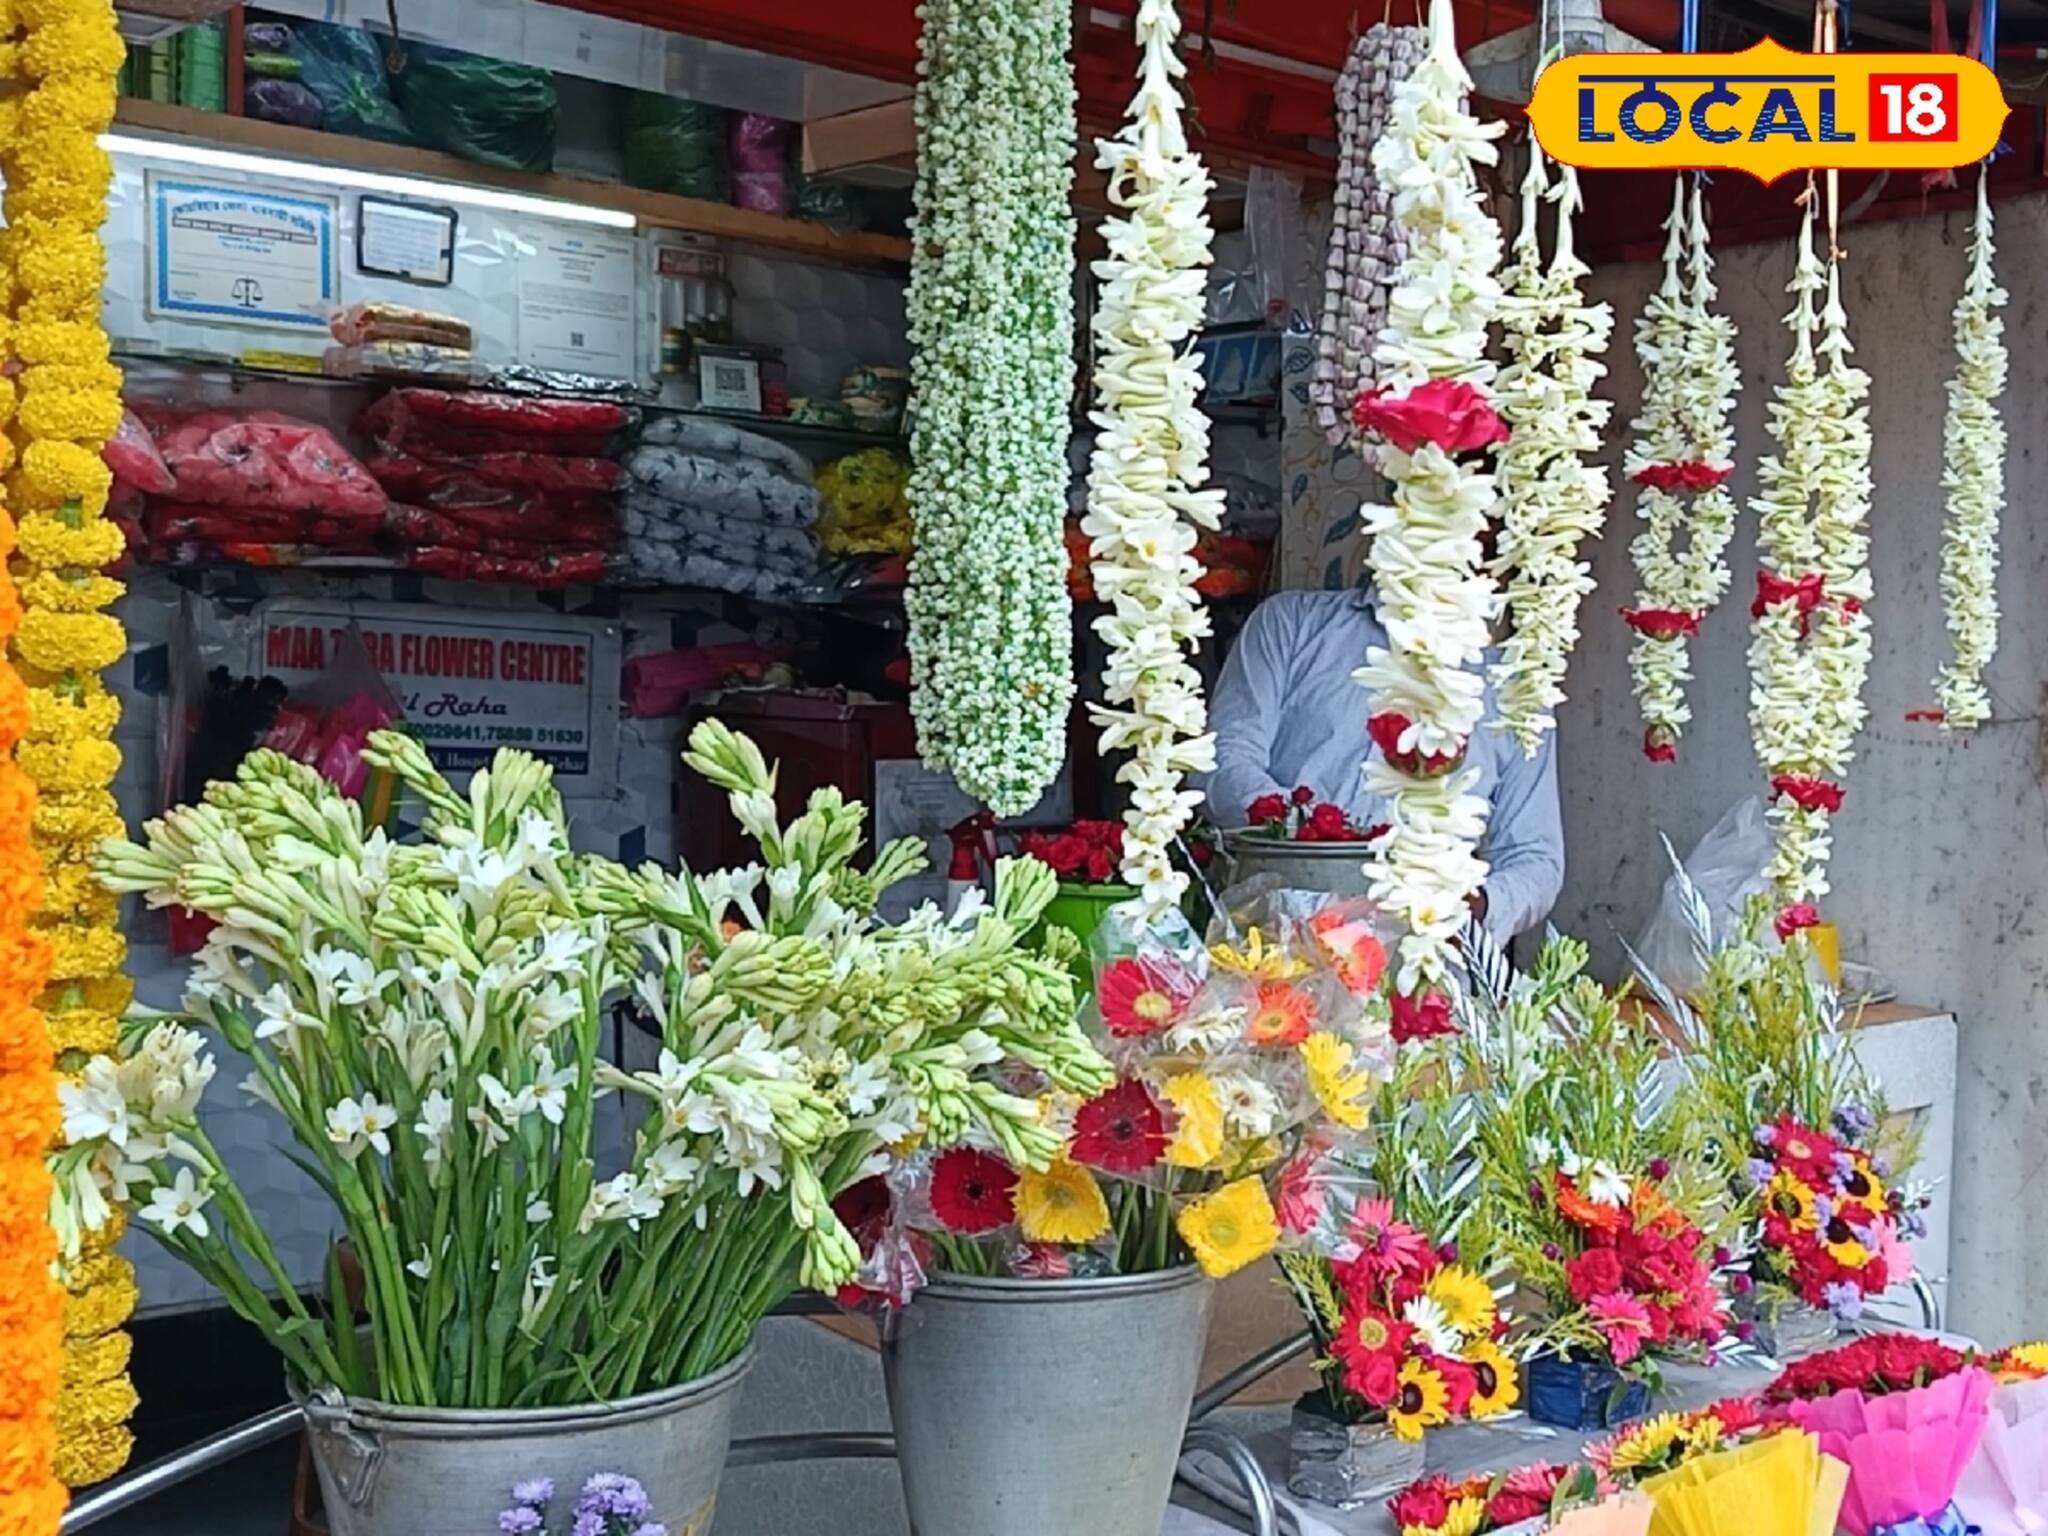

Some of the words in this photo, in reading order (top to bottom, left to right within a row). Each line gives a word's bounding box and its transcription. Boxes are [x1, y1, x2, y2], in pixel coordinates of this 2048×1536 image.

[267, 625, 324, 669] MAA
[401, 633, 494, 680] FLOWER
[501, 640, 585, 685] CENTRE
[424, 693, 508, 717] Raha
